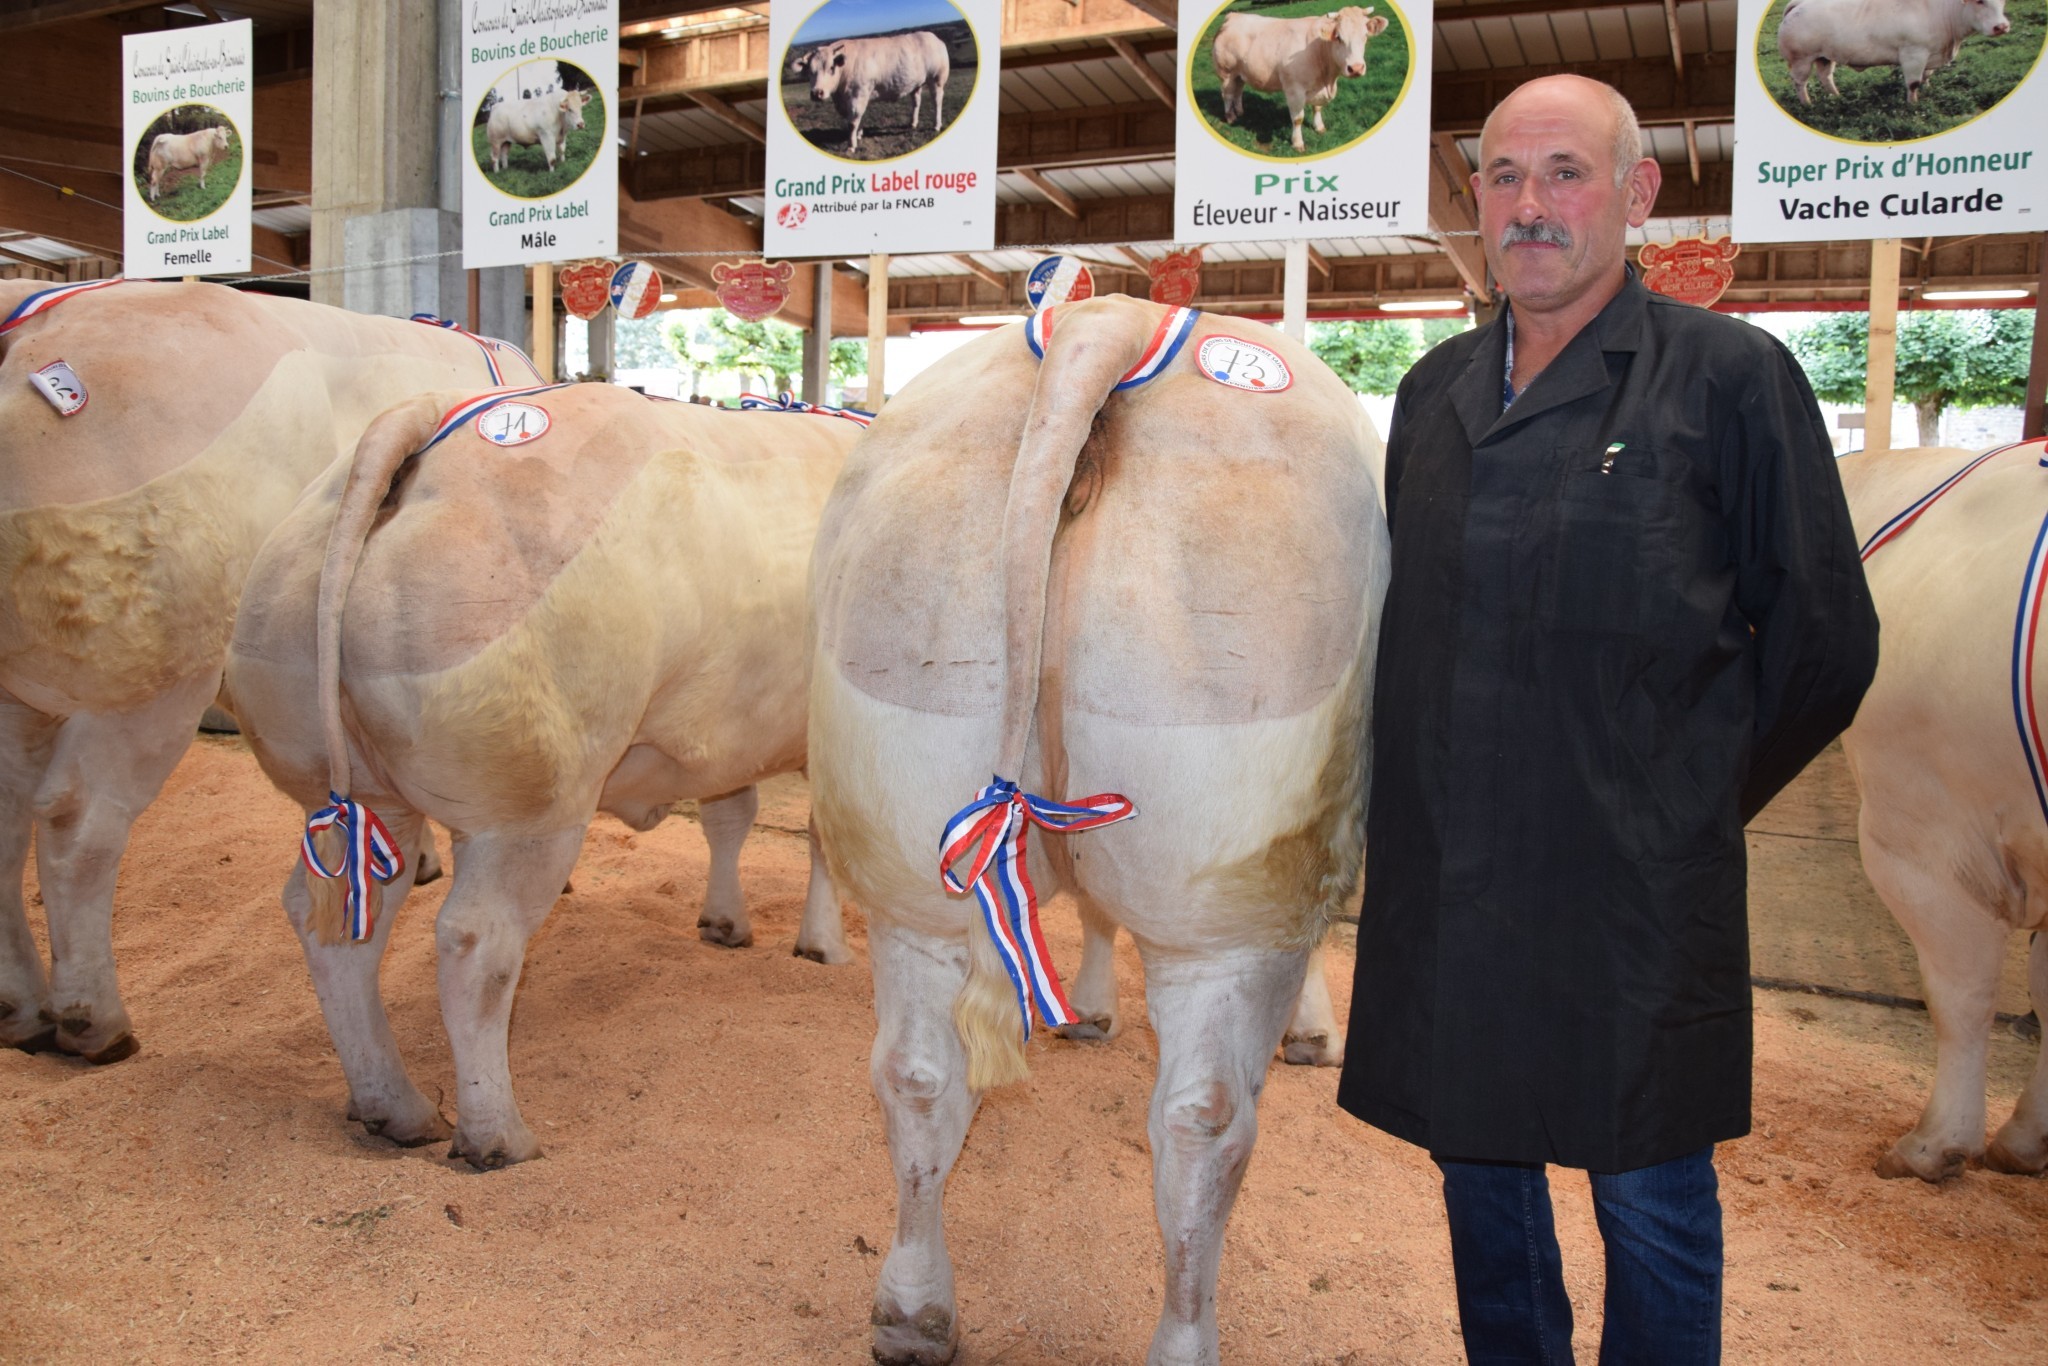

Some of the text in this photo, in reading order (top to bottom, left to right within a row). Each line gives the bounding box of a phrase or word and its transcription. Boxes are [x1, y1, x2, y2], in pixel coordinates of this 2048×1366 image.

[472, 25, 609, 64] Bovins de Boucherie
[133, 77, 245, 103] Bovins de Boucherie
[1758, 150, 2033, 188] Super Prix d'Honneur
[775, 169, 977, 198] Grand Prix Label rouge
[1254, 170, 1340, 195] Prix
[489, 200, 589, 226] Grand Prix Label
[812, 197, 935, 214] Attribué par la FNCAB
[1193, 200, 1278, 226] Éleveur
[1299, 197, 1401, 222] Naisseur
[1778, 188, 2003, 220] Vache Cularde
[147, 226, 228, 244] Grand Prix Label
[521, 231, 557, 249] Mâle
[164, 250, 211, 265] Femelle
